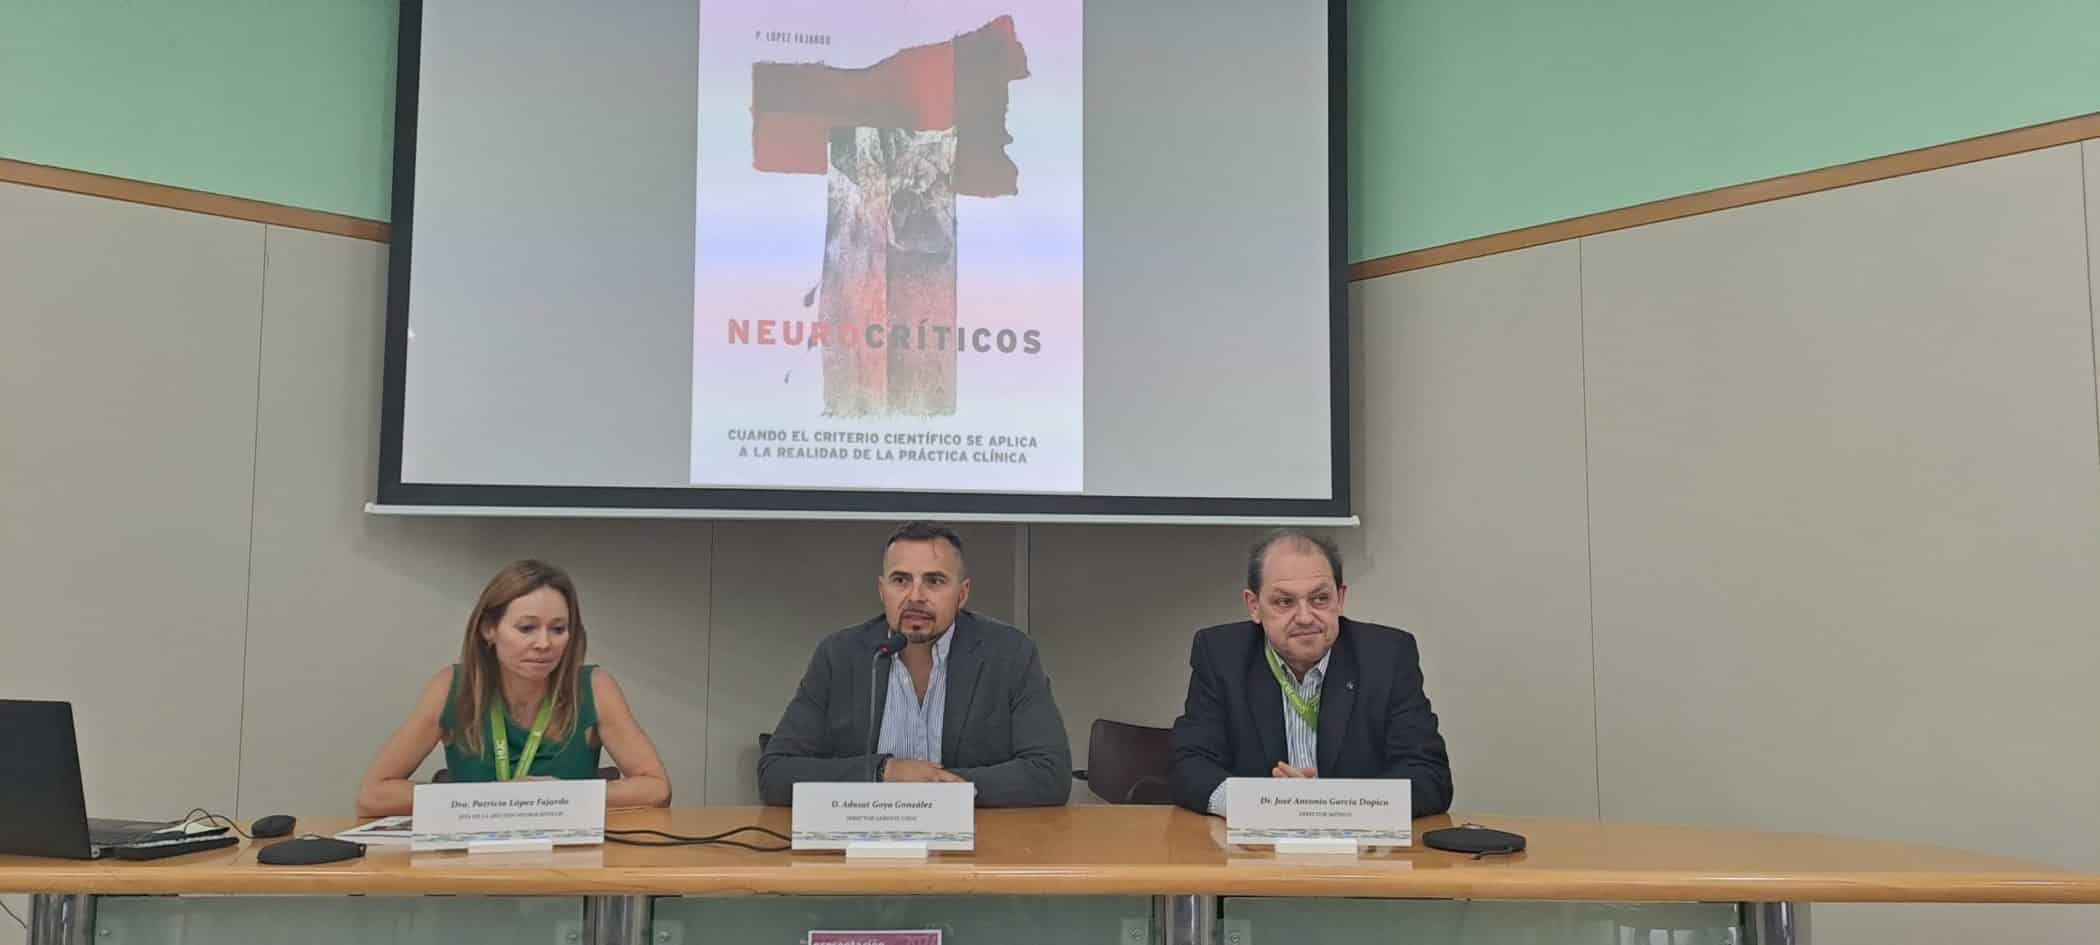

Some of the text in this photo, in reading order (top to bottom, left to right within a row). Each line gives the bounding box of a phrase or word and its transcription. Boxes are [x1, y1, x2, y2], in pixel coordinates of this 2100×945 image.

[727, 319, 1041, 355] NEUROCRÍTICOS
[728, 429, 1038, 448] CUANDO EL CRITERIO CIENTÍFICO SE APLICA
[738, 446, 1028, 463] A LA REALIDAD DE LA PRÁCTICA CLÍNICA
